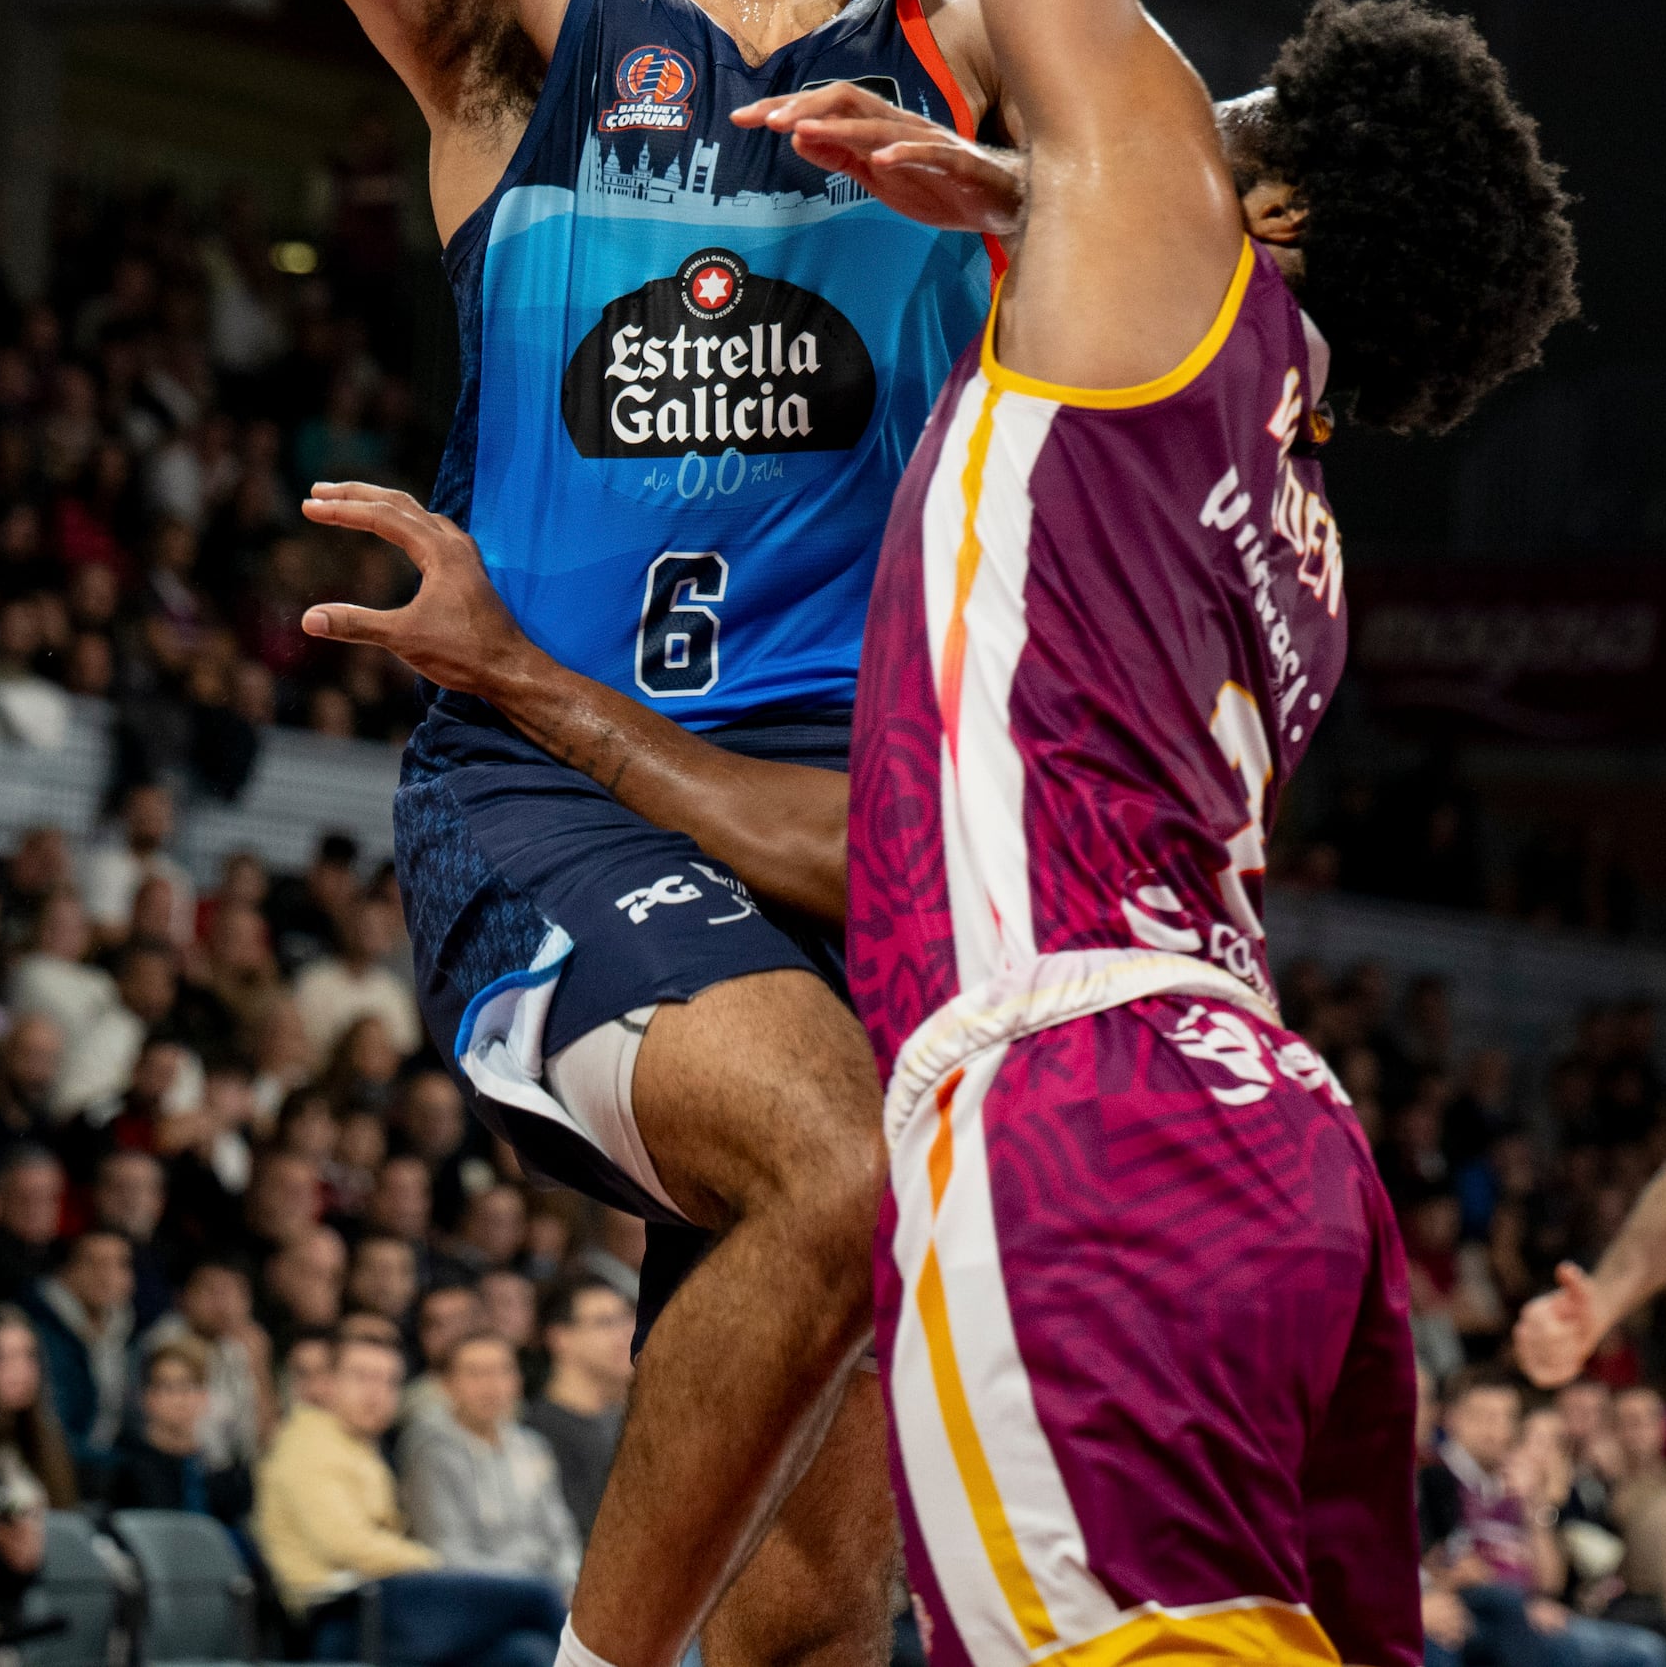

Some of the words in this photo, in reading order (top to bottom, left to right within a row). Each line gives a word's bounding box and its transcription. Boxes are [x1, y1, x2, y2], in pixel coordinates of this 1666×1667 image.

[618, 103, 681, 115] BASQUET
[604, 322, 822, 382] Estrella
[610, 382, 814, 445] Galicia
[676, 446, 747, 501] 0,0
[636, 550, 730, 699] 6
